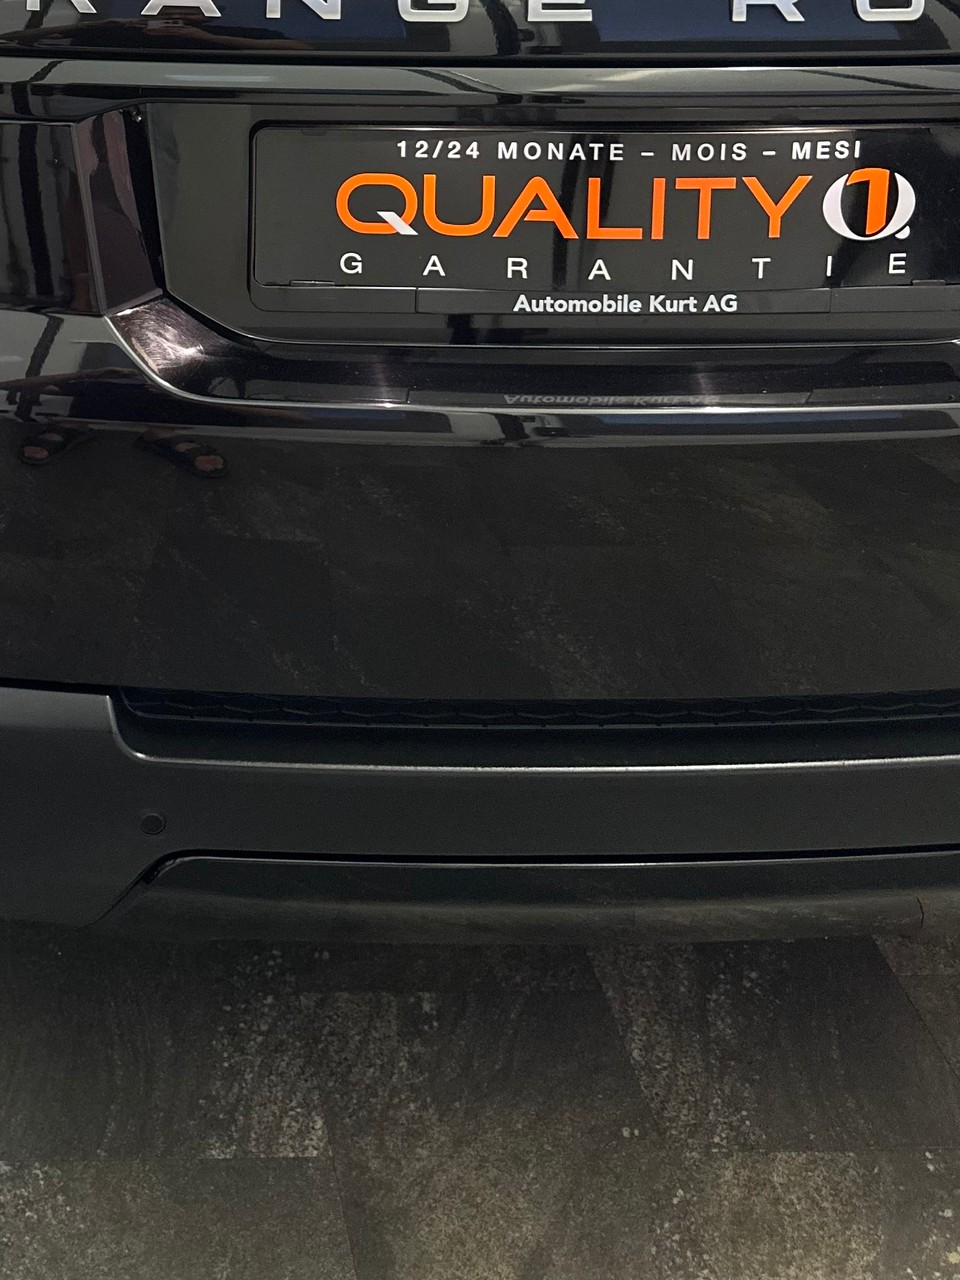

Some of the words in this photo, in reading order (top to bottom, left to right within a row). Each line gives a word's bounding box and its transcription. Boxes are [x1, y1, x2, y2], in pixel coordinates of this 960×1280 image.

[396, 140, 480, 159] 12/24
[497, 141, 624, 161] MONATE
[671, 142, 747, 162] MOIS
[791, 140, 861, 161] MESI
[335, 172, 812, 241] QUALITY
[339, 252, 907, 281] GARANTIE
[512, 293, 643, 313] Automobile
[649, 294, 698, 313] Kurt
[702, 293, 738, 313] AG
